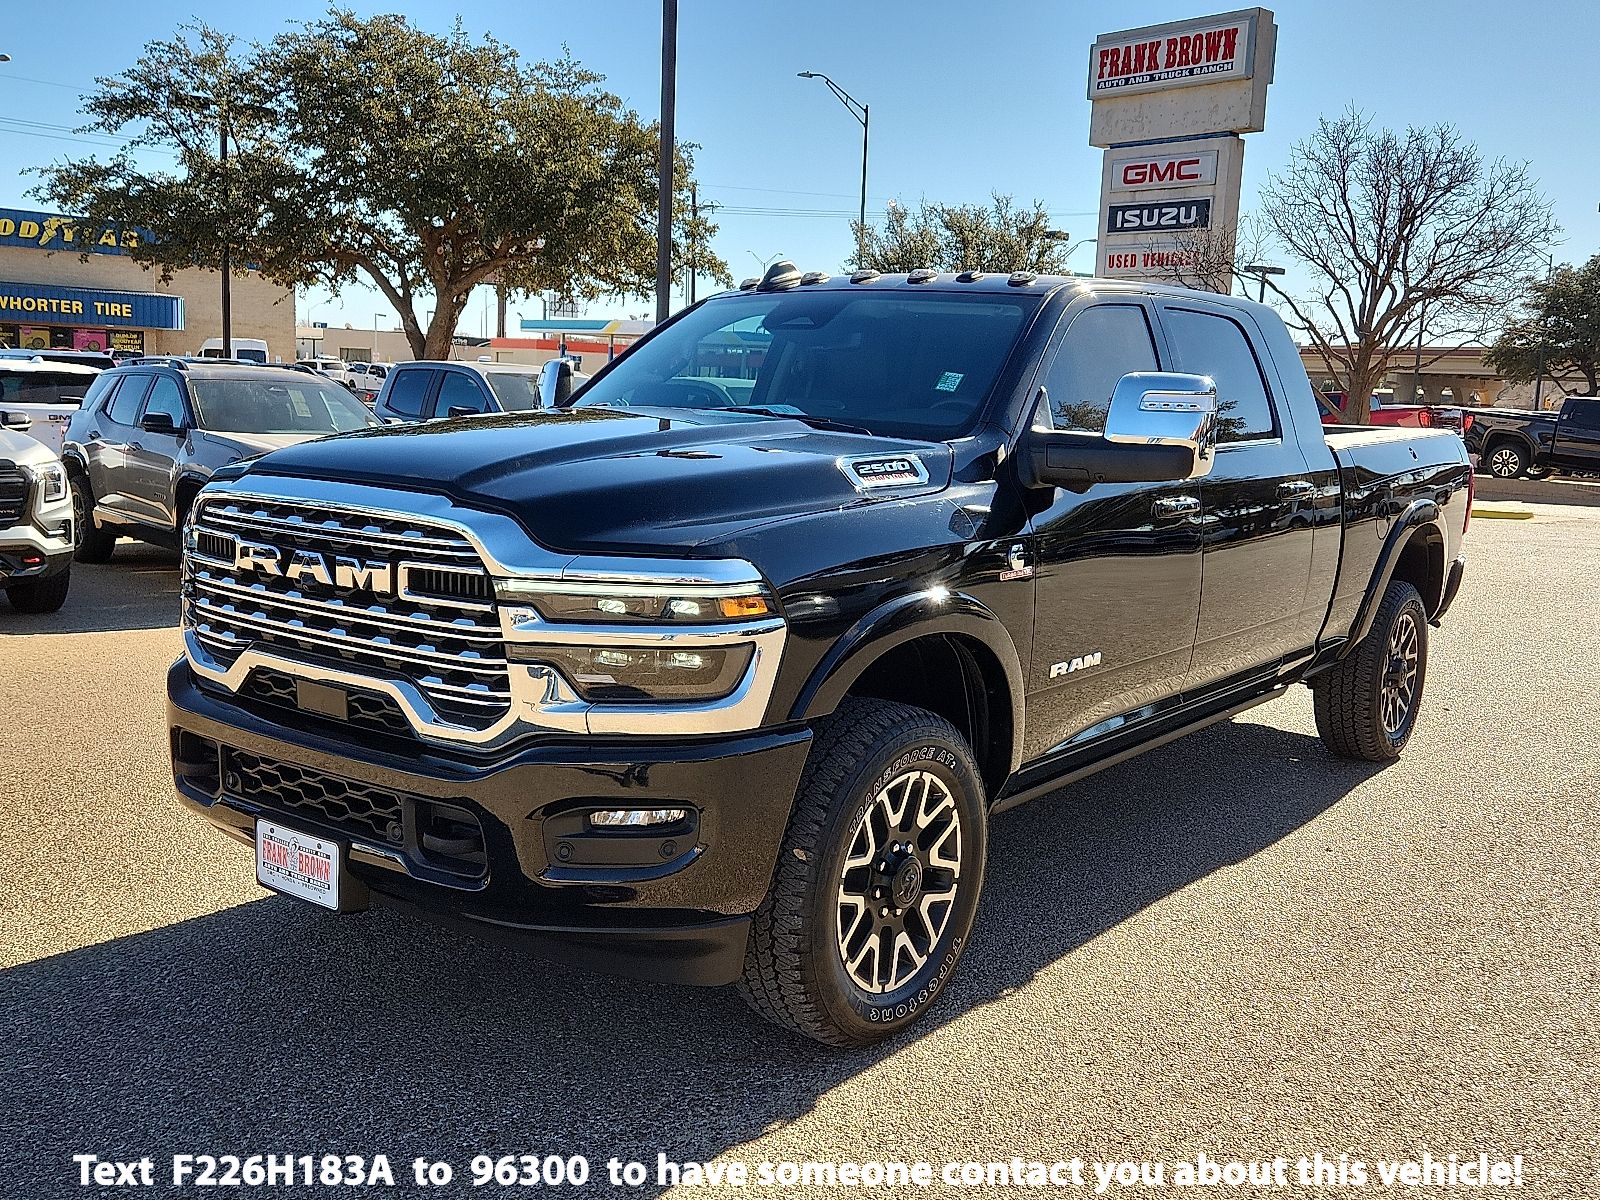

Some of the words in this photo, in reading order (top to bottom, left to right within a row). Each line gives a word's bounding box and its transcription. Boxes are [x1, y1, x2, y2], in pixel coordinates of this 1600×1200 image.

[1098, 40, 1161, 79] FRANK
[1164, 27, 1238, 69] BROWN
[1098, 78, 1125, 89] AUTO
[1128, 75, 1150, 84] AND
[1153, 69, 1190, 80] TRUCK
[1193, 62, 1232, 75] RANCH
[1122, 159, 1200, 185] GMC
[1116, 205, 1197, 228] ISUZU
[1108, 253, 1137, 268] USED
[93, 301, 132, 317] TIRE
[857, 460, 911, 474] 2500
[236, 540, 391, 594] RAM
[1049, 651, 1102, 679] RAM
[263, 839, 288, 868] FRANK
[298, 852, 331, 882] BROWN
